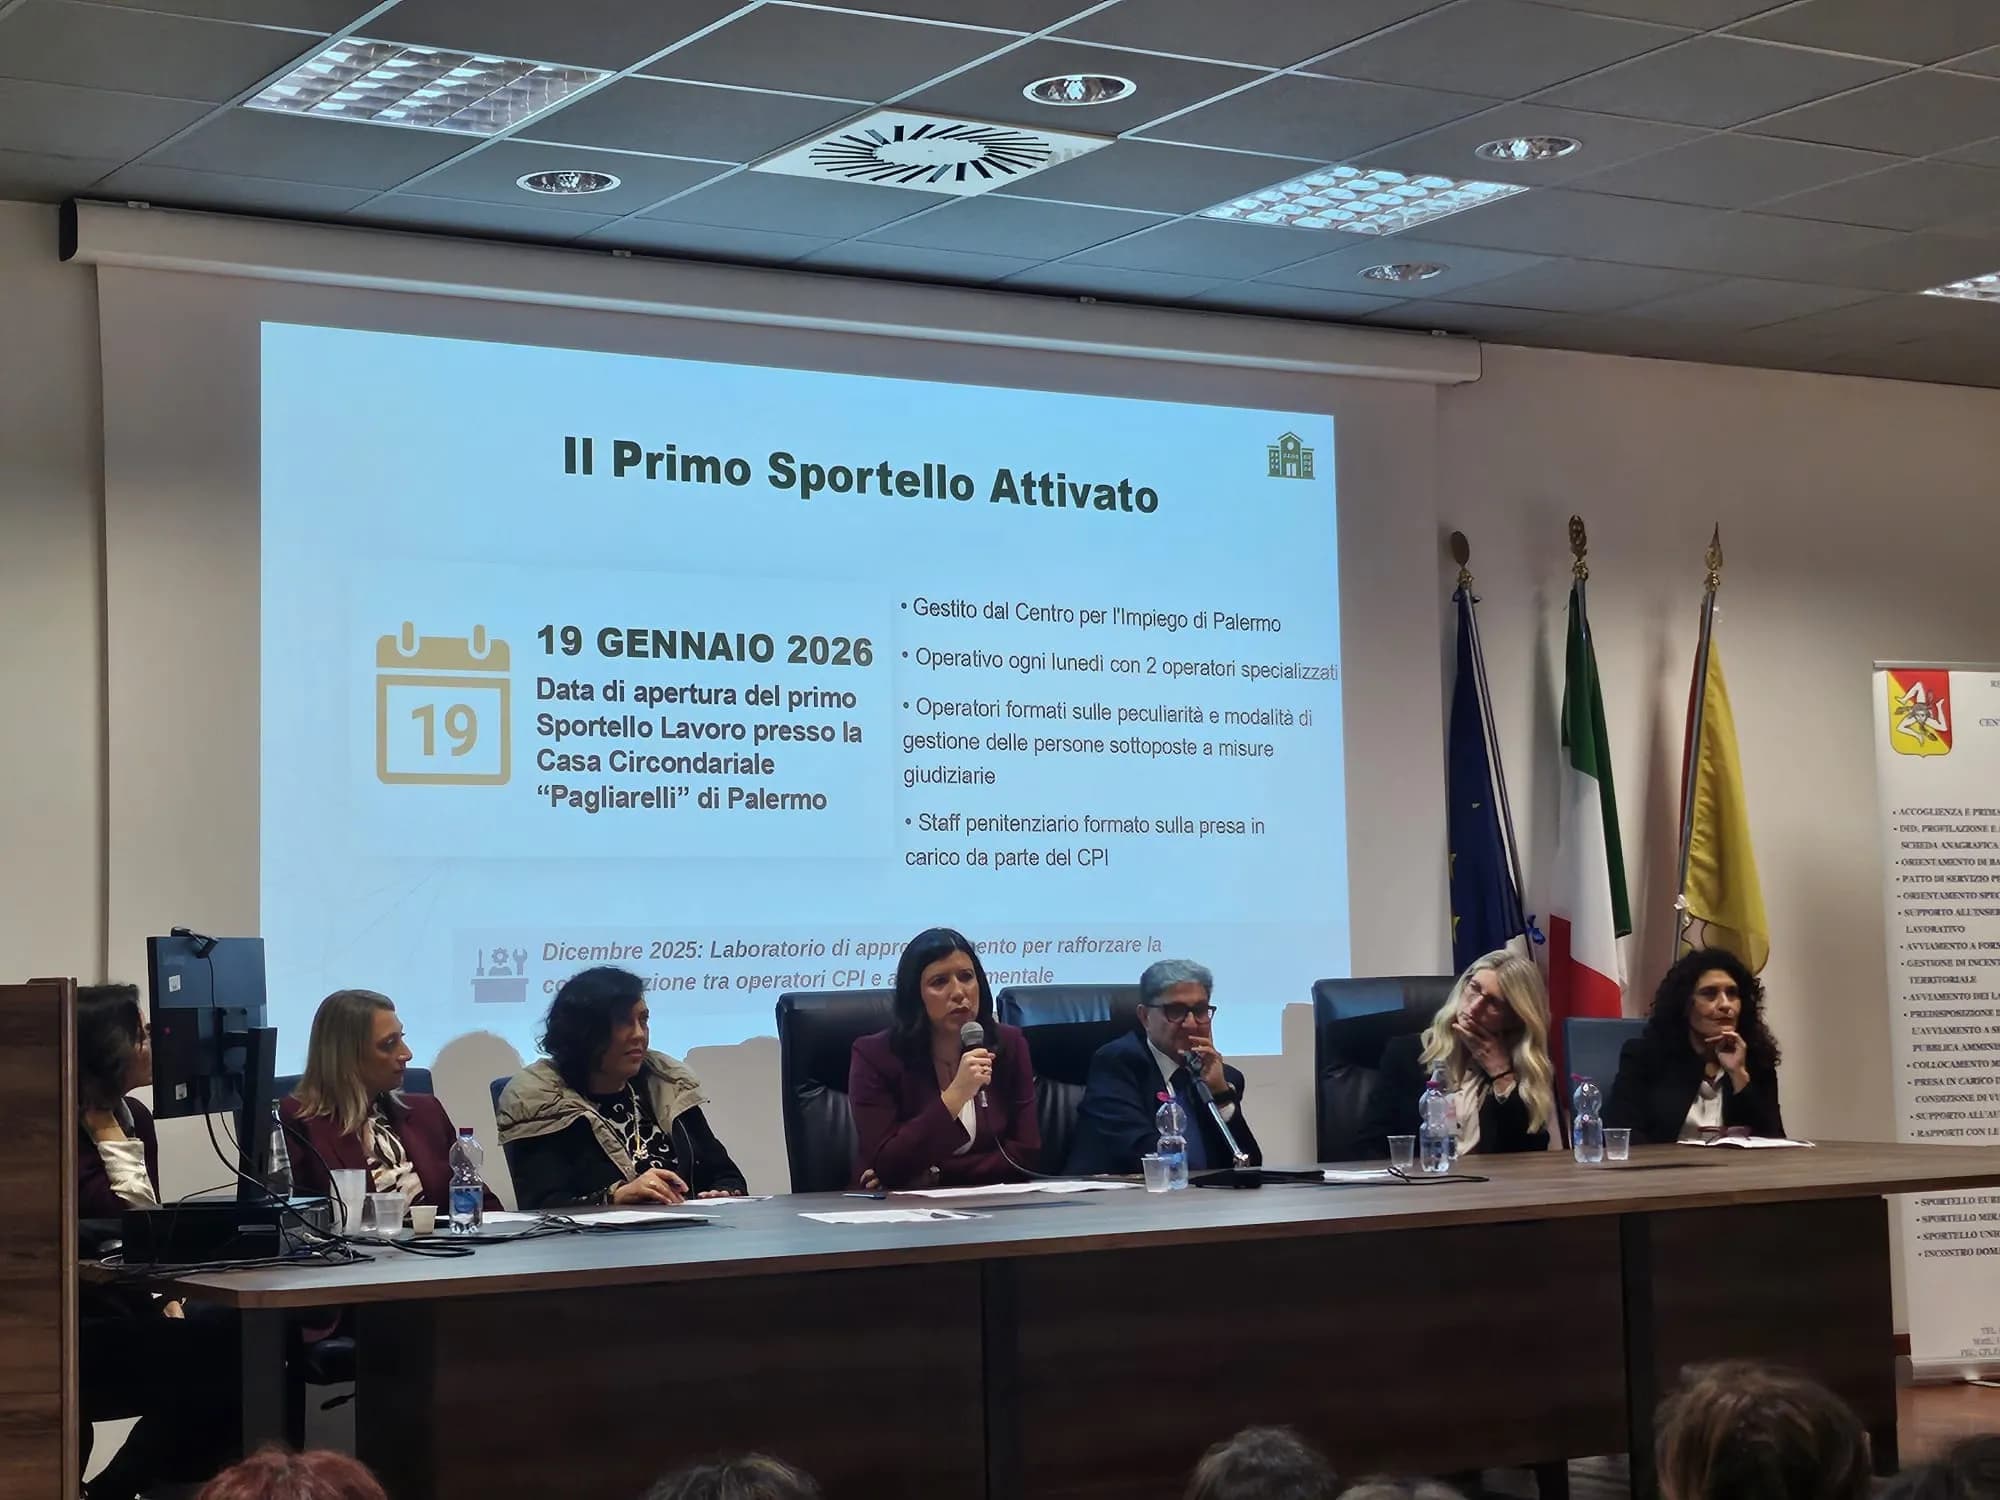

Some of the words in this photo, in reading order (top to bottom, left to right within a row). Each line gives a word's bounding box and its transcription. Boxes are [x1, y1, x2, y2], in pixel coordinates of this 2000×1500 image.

[613, 439, 752, 487] Primo
[767, 451, 975, 502] Sportello
[989, 468, 1159, 514] Attivato
[913, 597, 978, 619] Gestito
[982, 600, 1009, 620] dal
[1015, 602, 1074, 624] Centro
[1079, 609, 1108, 629] per
[1193, 610, 1208, 630] di
[1213, 611, 1281, 633] Palermo
[537, 624, 583, 657] 19
[596, 626, 775, 664] GENNAIO
[787, 634, 873, 667] 2026
[915, 647, 1003, 671] Operativo
[1008, 651, 1046, 675] ogni
[1110, 658, 1141, 674] con
[1146, 656, 1157, 675] 2
[1162, 659, 1236, 680] operatori
[1241, 661, 1338, 683] specializzati
[536, 676, 595, 702] Data
[602, 679, 625, 703] di
[633, 683, 737, 710] apertura
[744, 683, 780, 707] del
[788, 690, 857, 713] primo
[916, 696, 1000, 721] Operatori
[1005, 699, 1067, 720] formati
[1072, 702, 1112, 721] sulle
[1117, 704, 1204, 726] peculiarità
[1208, 710, 1220, 724] e
[1224, 708, 1294, 727] modalità
[1298, 709, 1313, 727] di
[411, 703, 478, 757] 19
[536, 712, 654, 743] Sportello
[661, 715, 747, 741] Lavoro
[753, 723, 836, 747] presso
[842, 720, 863, 744] la
[902, 731, 980, 754] gestione
[986, 732, 1028, 752] delle
[1034, 737, 1105, 757] persone
[1109, 736, 1197, 760] sottoposte
[1202, 742, 1213, 756] a
[1218, 739, 1274, 758] misure
[536, 748, 602, 773] Casa
[608, 749, 775, 775] Circondariale
[903, 764, 996, 788] giudiziarie
[697, 786, 720, 809] di
[727, 786, 828, 811] Palermo
[1899, 807, 1962, 816] ACCOGLIENZA
[918, 812, 961, 832] Staff
[966, 813, 1079, 837] penitenziario
[1083, 814, 1150, 834] formato
[1155, 815, 1195, 834] sulla
[1199, 820, 1246, 839] presa
[1250, 816, 1265, 835] in
[905, 847, 960, 866] carico
[966, 847, 989, 866] da
[994, 848, 1040, 871] parte
[1045, 847, 1072, 867] del
[1077, 847, 1109, 867] CPI
[1901, 858, 1975, 866] ORIENTAMENTO
[1902, 874, 1932, 883] PATTO
[1946, 874, 1989, 883] SERVIZIO
[1903, 891, 1977, 900] ORIENTAMENTO
[1904, 908, 1953, 917] SUPPORTO
[1906, 925, 1965, 934] LAVORATIVO
[542, 941, 643, 961] Dicembre
[649, 940, 703, 960] 2025:
[710, 938, 826, 960] Laboratorio
[831, 938, 851, 957] di
[1022, 940, 1052, 958] per
[1056, 937, 1143, 954] rafforzare
[1147, 936, 1163, 954] la
[1907, 942, 1968, 950] AVVIAMENTO
[1907, 959, 1953, 968] GESTIONE
[703, 972, 730, 991] tra
[736, 969, 826, 994] operatori
[831, 969, 866, 988] CPI
[871, 973, 882, 986] e
[1909, 975, 1977, 984] TERRITORIALE
[1909, 992, 1971, 1001] AVVIAMENTO
[1912, 1043, 1959, 1052] PUBBLICA
[1913, 1060, 1989, 1069] COLLOCAMENTO
[1914, 1078, 1944, 1087] PRESA
[1958, 1076, 1994, 1085] CARICO
[1915, 1094, 1976, 1103] CONDIZIONE
[1916, 1111, 1966, 1120] SUPPORTO
[1917, 1128, 1964, 1137] RAPPORTI
[1966, 1127, 1986, 1136] CON
[1921, 1197, 1975, 1206] SPORTELLO
[1922, 1214, 1976, 1223] SPORTELLO
[1922, 1231, 1977, 1240] SPORTELLO
[1924, 1248, 1973, 1257] INCONTRO
